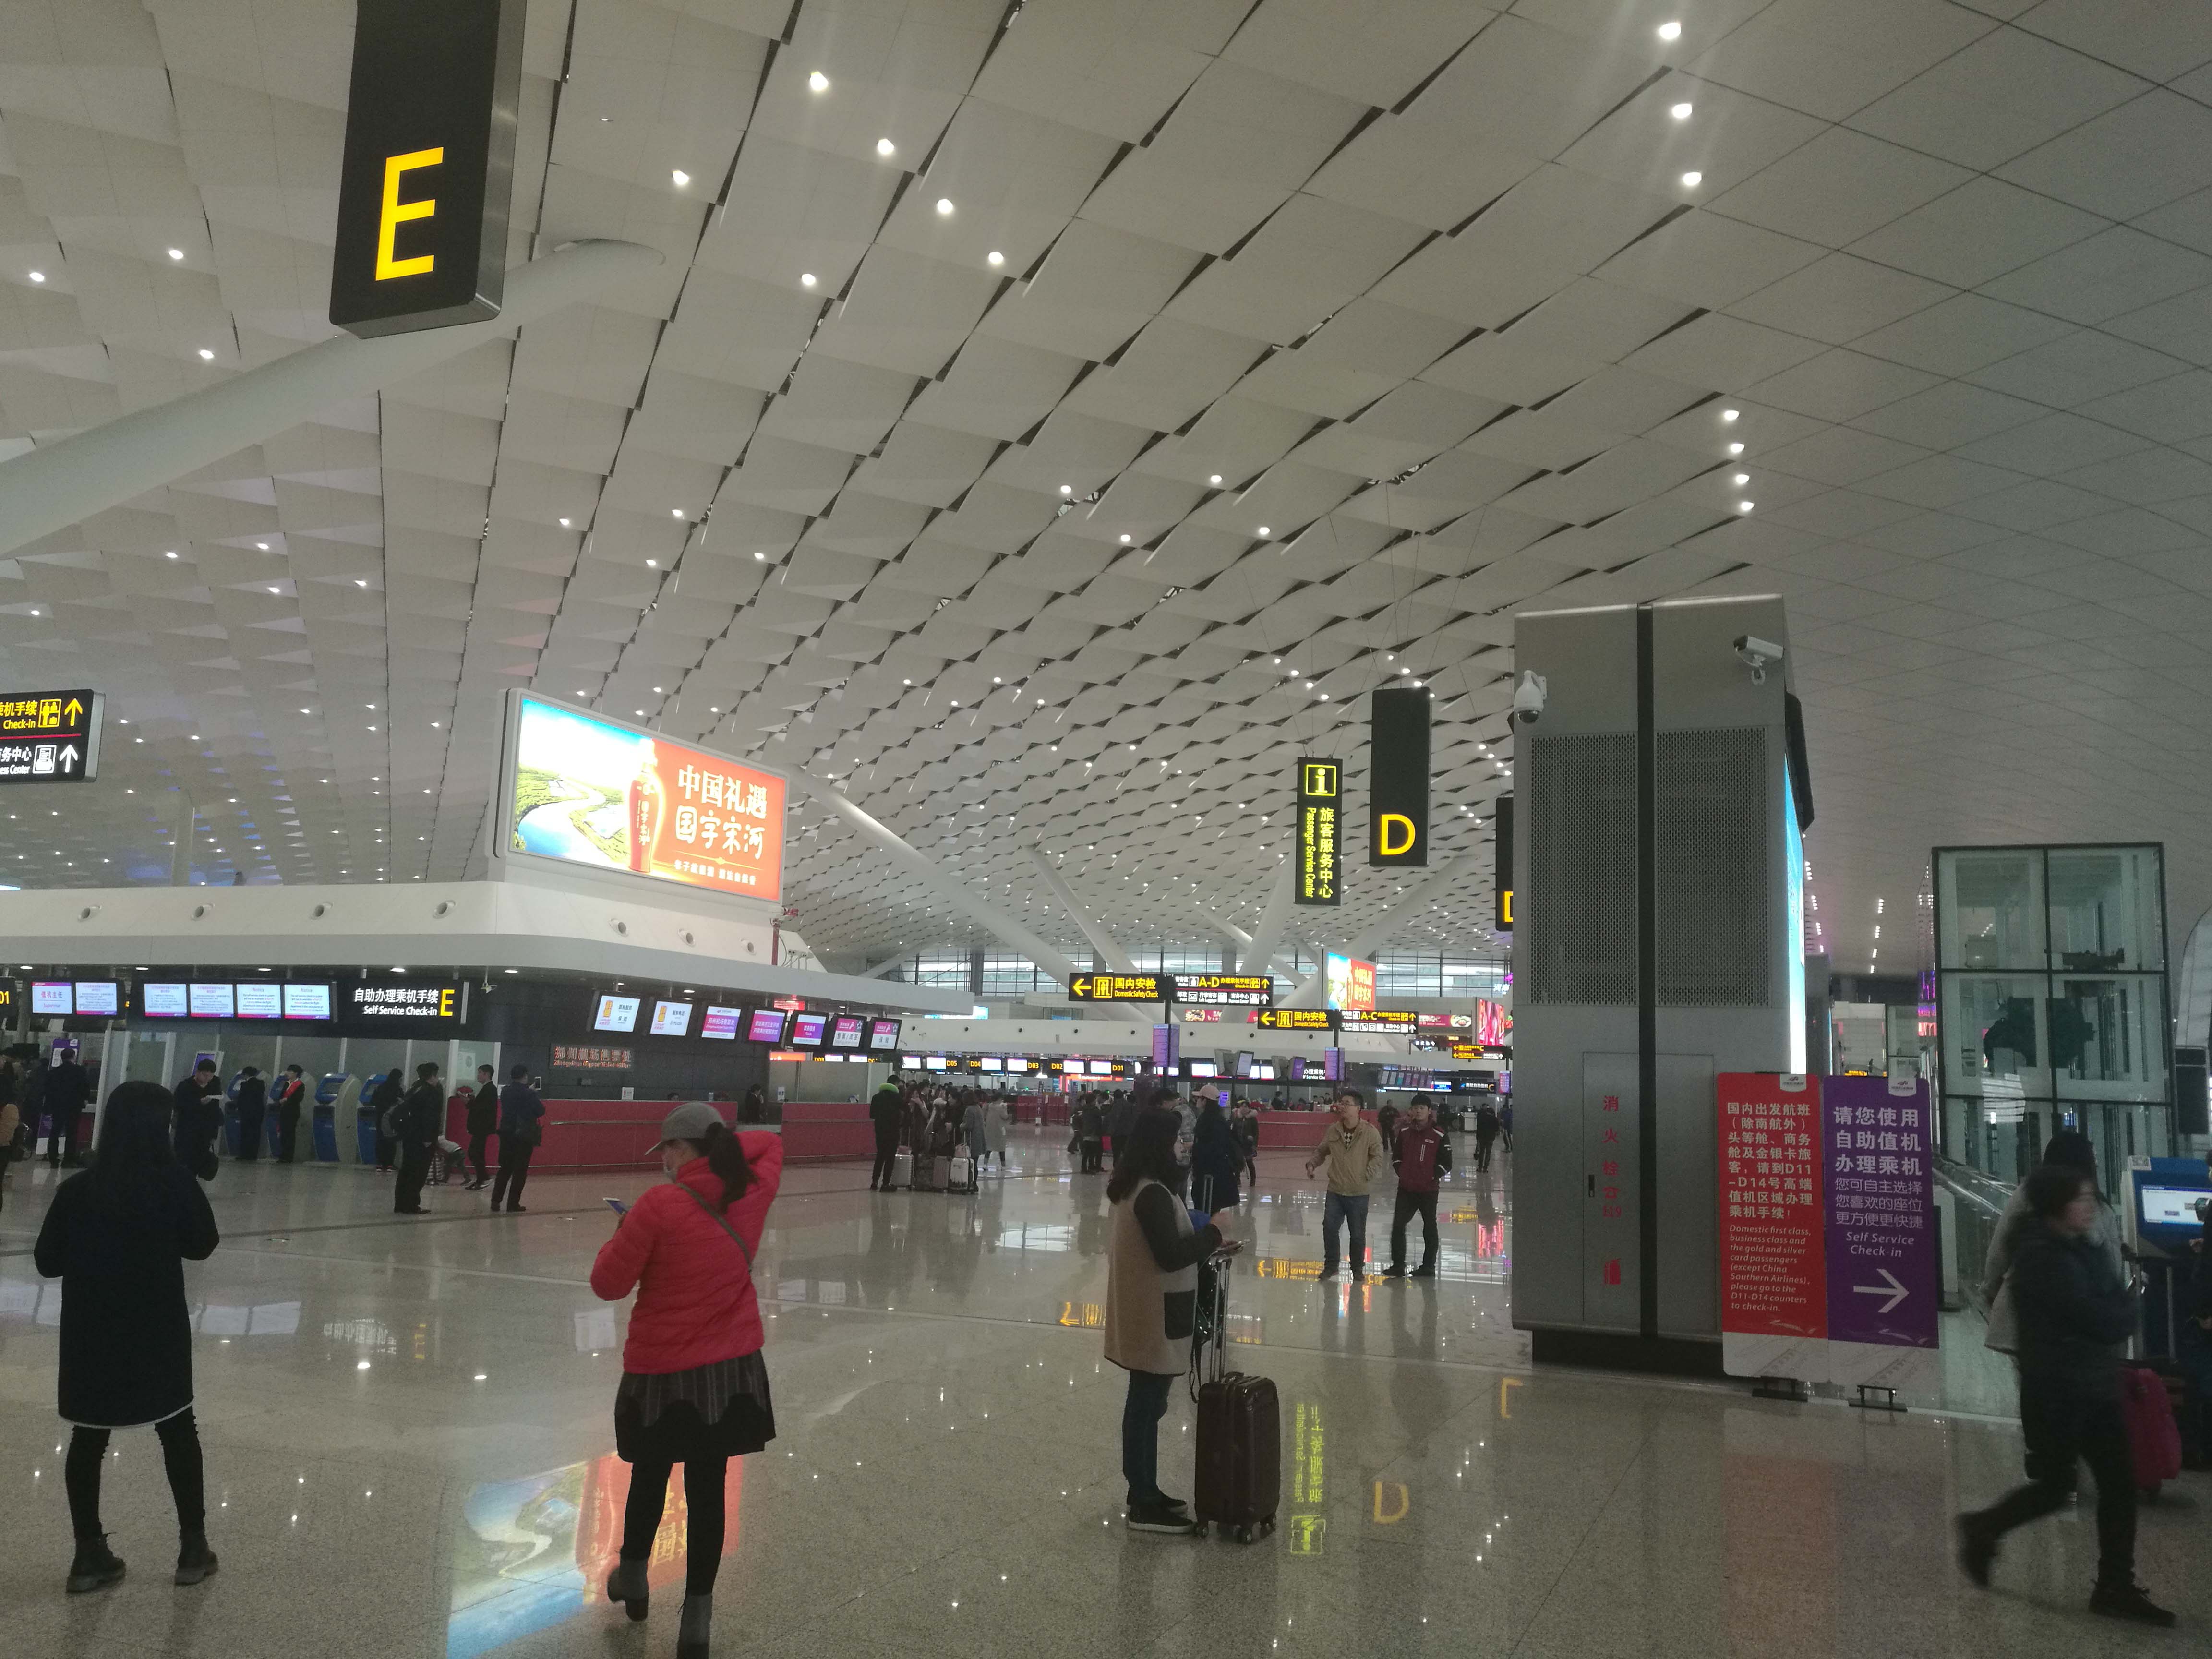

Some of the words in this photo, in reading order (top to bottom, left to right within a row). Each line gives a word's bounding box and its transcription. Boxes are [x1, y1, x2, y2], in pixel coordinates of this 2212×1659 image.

[375, 146, 444, 281] E
[3, 719, 36, 730] Check-in
[0, 746, 32, 762] 务中心
[10, 765, 31, 774] Center
[678, 764, 768, 819] 中国礼遇
[675, 805, 766, 860] 国字宋河
[1304, 807, 1317, 845] Passenger
[1380, 813, 1416, 855] D
[1306, 846, 1316, 873] Service
[1319, 807, 1334, 898] 旅客服务中心
[1306, 873, 1316, 898] Center
[1115, 978, 1156, 990] 国内安检
[1198, 976, 1220, 987] A-D
[354, 988, 439, 1003] 自助办理乘机手续
[440, 989, 455, 1016] E
[363, 1005, 378, 1014] Self
[379, 1006, 404, 1015] Service
[406, 1006, 437, 1016] Check-in
[1294, 1011, 1327, 1021] 国内安检
[1361, 1011, 1377, 1020] A-C
[554, 1046, 632, 1062] 郑州机场售票处
[1728, 1102, 1811, 1116] 国内出发航班
[1834, 1106, 1919, 1127] 请您使用
[1728, 1132, 1811, 1145] 头等舱、商务
[1836, 1130, 1921, 1152] 自助值机
[1728, 1146, 1811, 1160] 舱及金银卡旅
[1835, 1154, 1922, 1176] 办理乘机
[1835, 1177, 1923, 1195] 您可自主选择
[1729, 1190, 1813, 1205] 值机区域办理
[1835, 1195, 1923, 1212] 您喜欢的座位
[1835, 1212, 1923, 1229] 更方便更快捷
[1730, 1225, 1769, 1233] Domestic
[1788, 1227, 1811, 1236] class,
[1730, 1234, 1765, 1242] business
[1846, 1231, 1869, 1242] Self
[1872, 1232, 1914, 1245] Service
[1850, 1245, 1902, 1257] Check-in
[1750, 1256, 1797, 1264] passengers
[1731, 1263, 1760, 1272] (except
[1762, 1264, 1787, 1273] China
[1731, 1273, 1769, 1281] Southern
[1731, 1292, 1768, 1300] D11-D14
[1770, 1295, 1807, 1304] counters
[1743, 1303, 1781, 1312] check-in.
